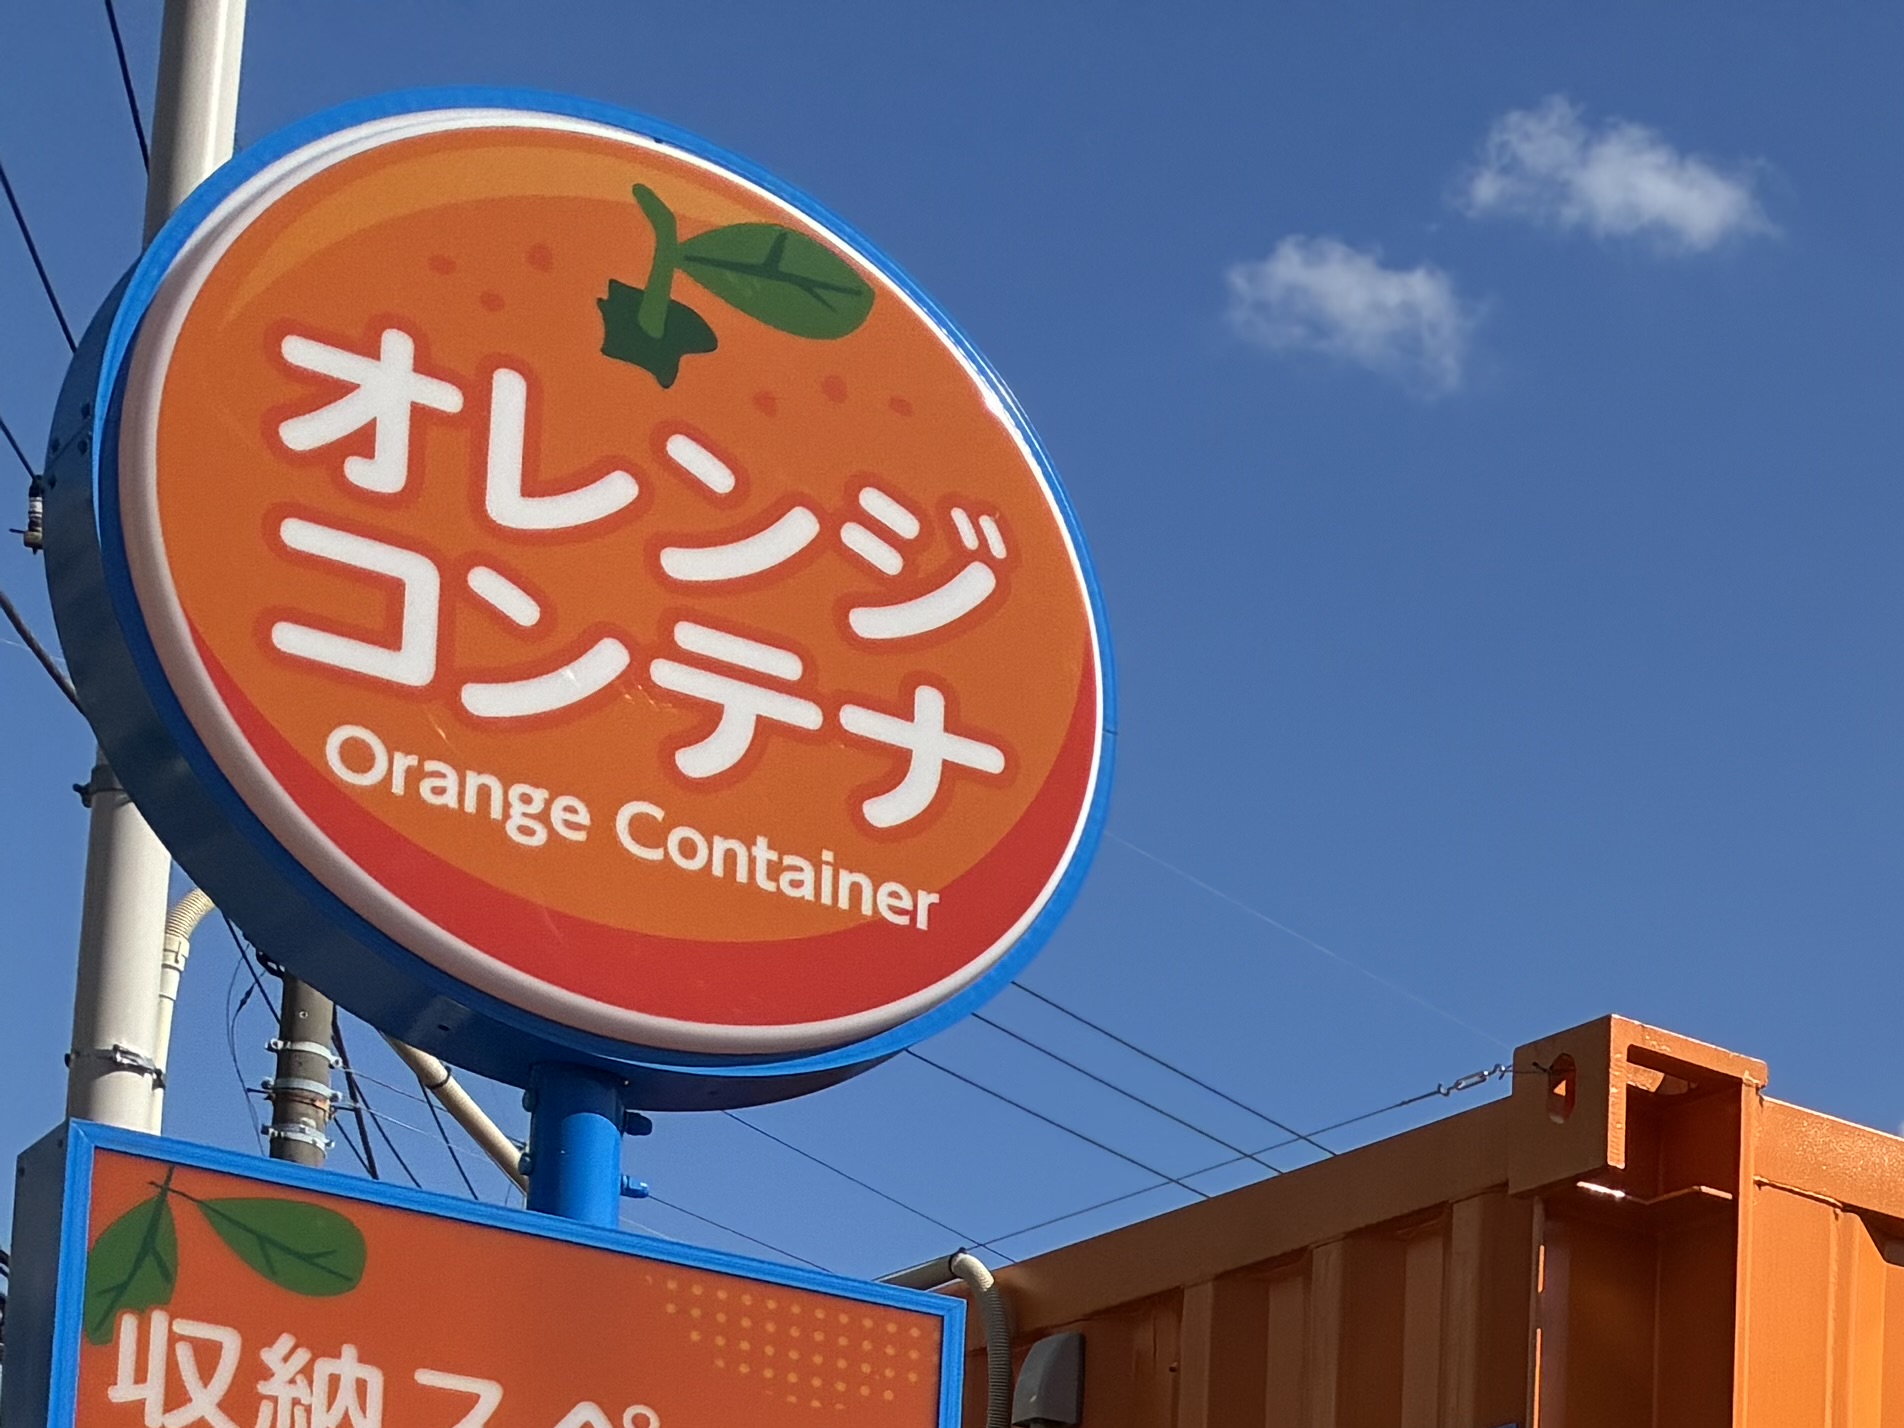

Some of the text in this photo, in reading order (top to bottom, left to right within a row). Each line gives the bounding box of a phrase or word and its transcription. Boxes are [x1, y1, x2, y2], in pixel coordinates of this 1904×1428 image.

[278, 328, 1008, 642] オレンジ
[271, 515, 1006, 834] コンテナ
[325, 723, 940, 931] Orange Container
